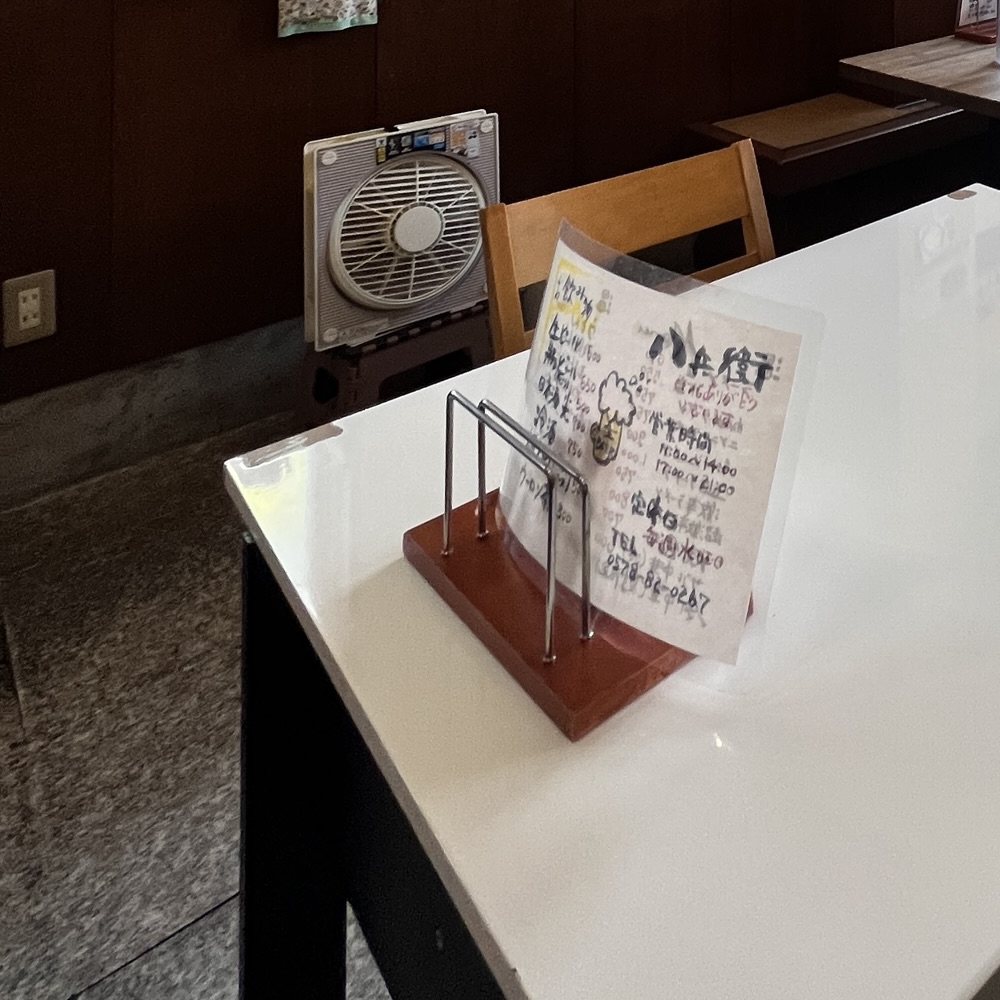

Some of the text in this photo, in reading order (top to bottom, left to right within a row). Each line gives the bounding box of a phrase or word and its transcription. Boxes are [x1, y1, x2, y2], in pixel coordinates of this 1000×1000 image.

[649, 410, 713, 455] 営業時間
[611, 527, 638, 557] TEL
